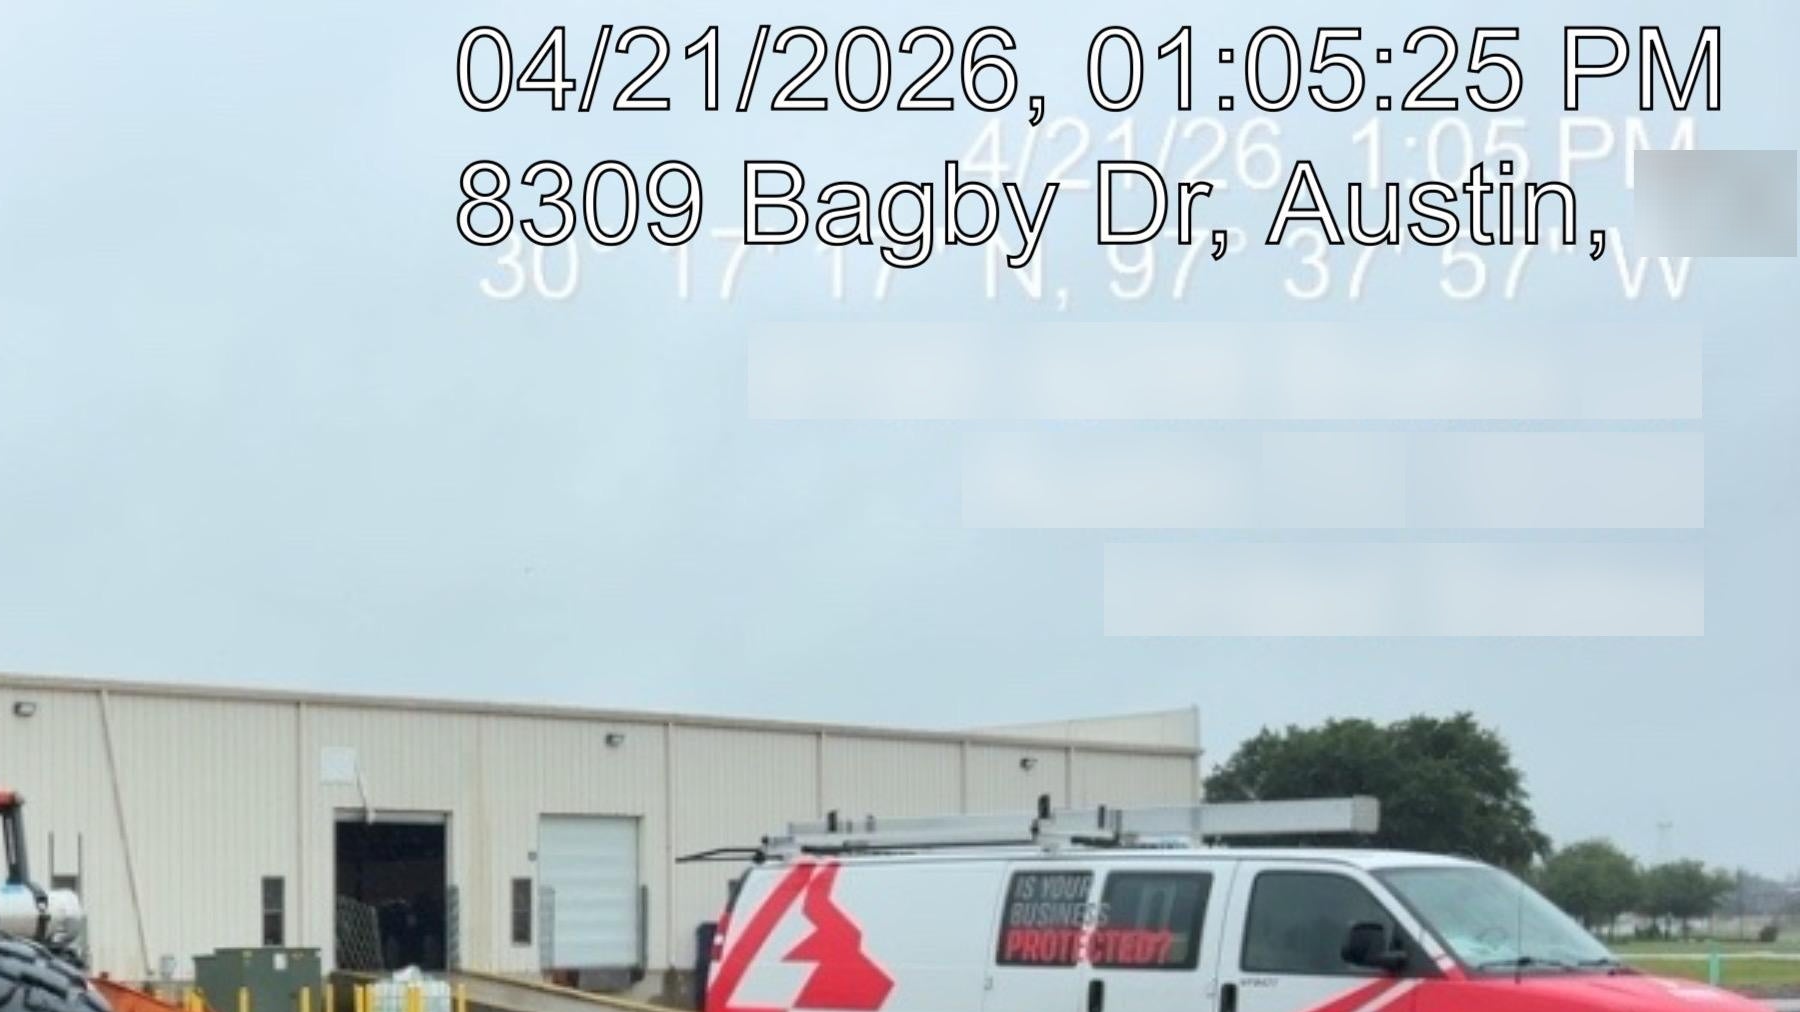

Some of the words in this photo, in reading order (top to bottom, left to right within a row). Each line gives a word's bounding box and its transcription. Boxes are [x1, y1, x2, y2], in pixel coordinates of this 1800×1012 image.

[1014, 875, 1037, 898] IS
[1009, 902, 1111, 927] BUSINESS
[1004, 927, 1173, 964] PROTECTED?
